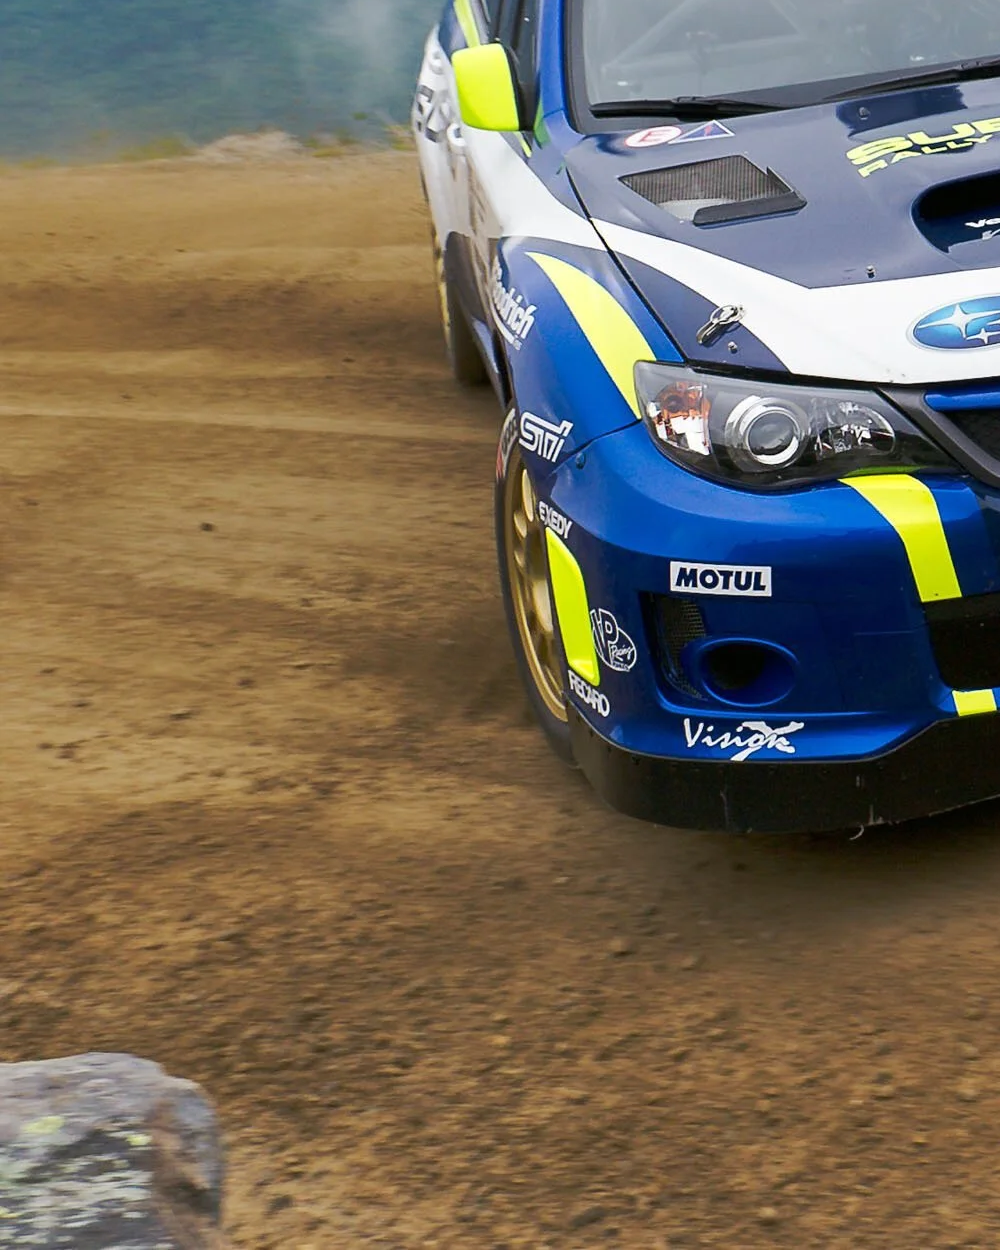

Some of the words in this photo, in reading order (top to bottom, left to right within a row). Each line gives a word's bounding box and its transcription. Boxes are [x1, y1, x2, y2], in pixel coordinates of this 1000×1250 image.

[857, 134, 993, 178] RALLY
[538, 500, 573, 539] EXEDY
[675, 566, 767, 592] MOTUL
[567, 669, 611, 718] RECARO
